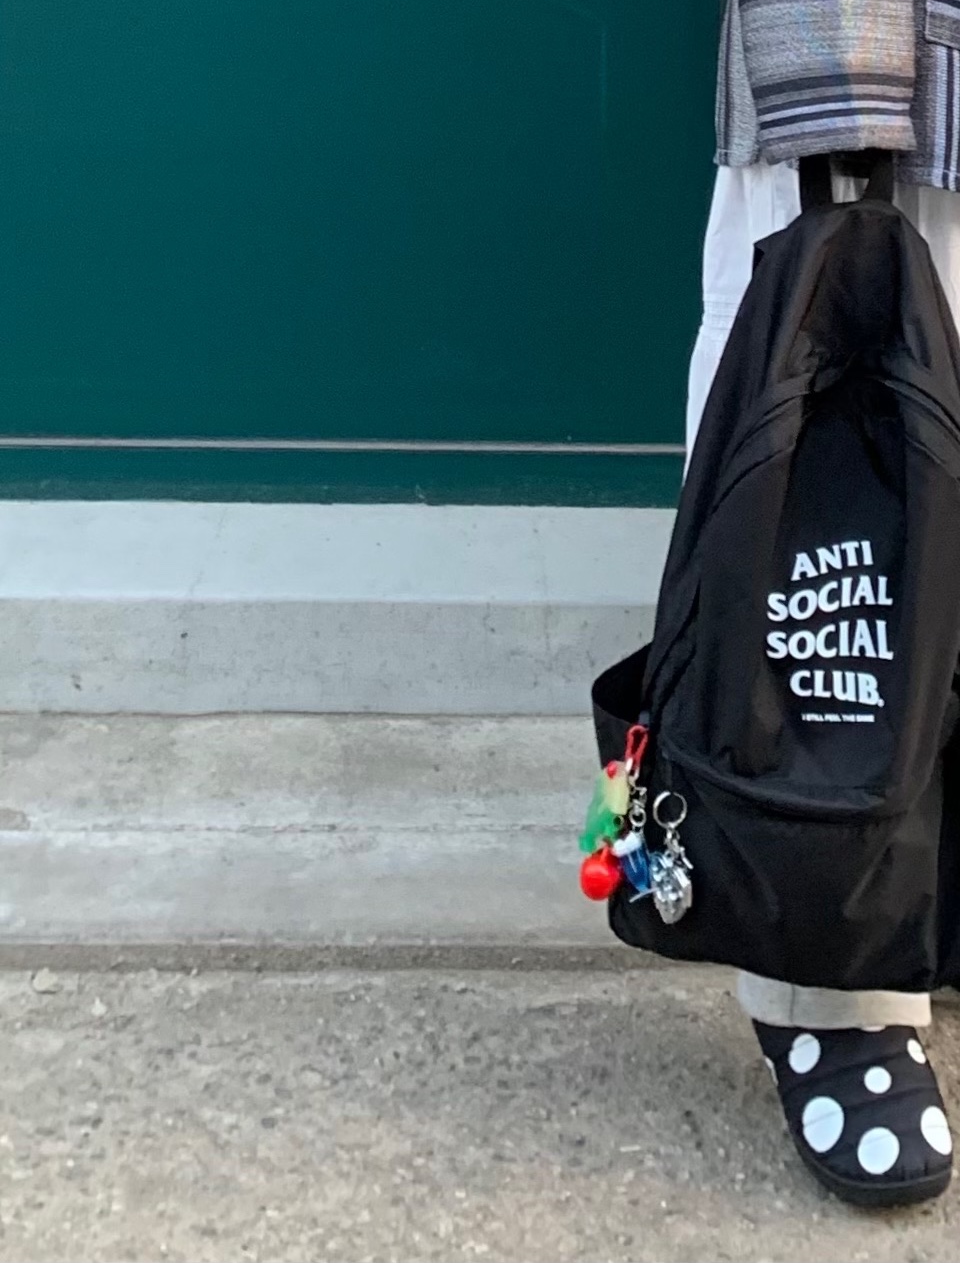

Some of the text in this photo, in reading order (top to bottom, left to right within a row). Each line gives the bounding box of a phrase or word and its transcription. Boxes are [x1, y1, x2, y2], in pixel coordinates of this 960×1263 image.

[791, 540, 873, 581] ANTI
[767, 575, 893, 622] SOCIAL
[766, 619, 894, 660] SOCIAL
